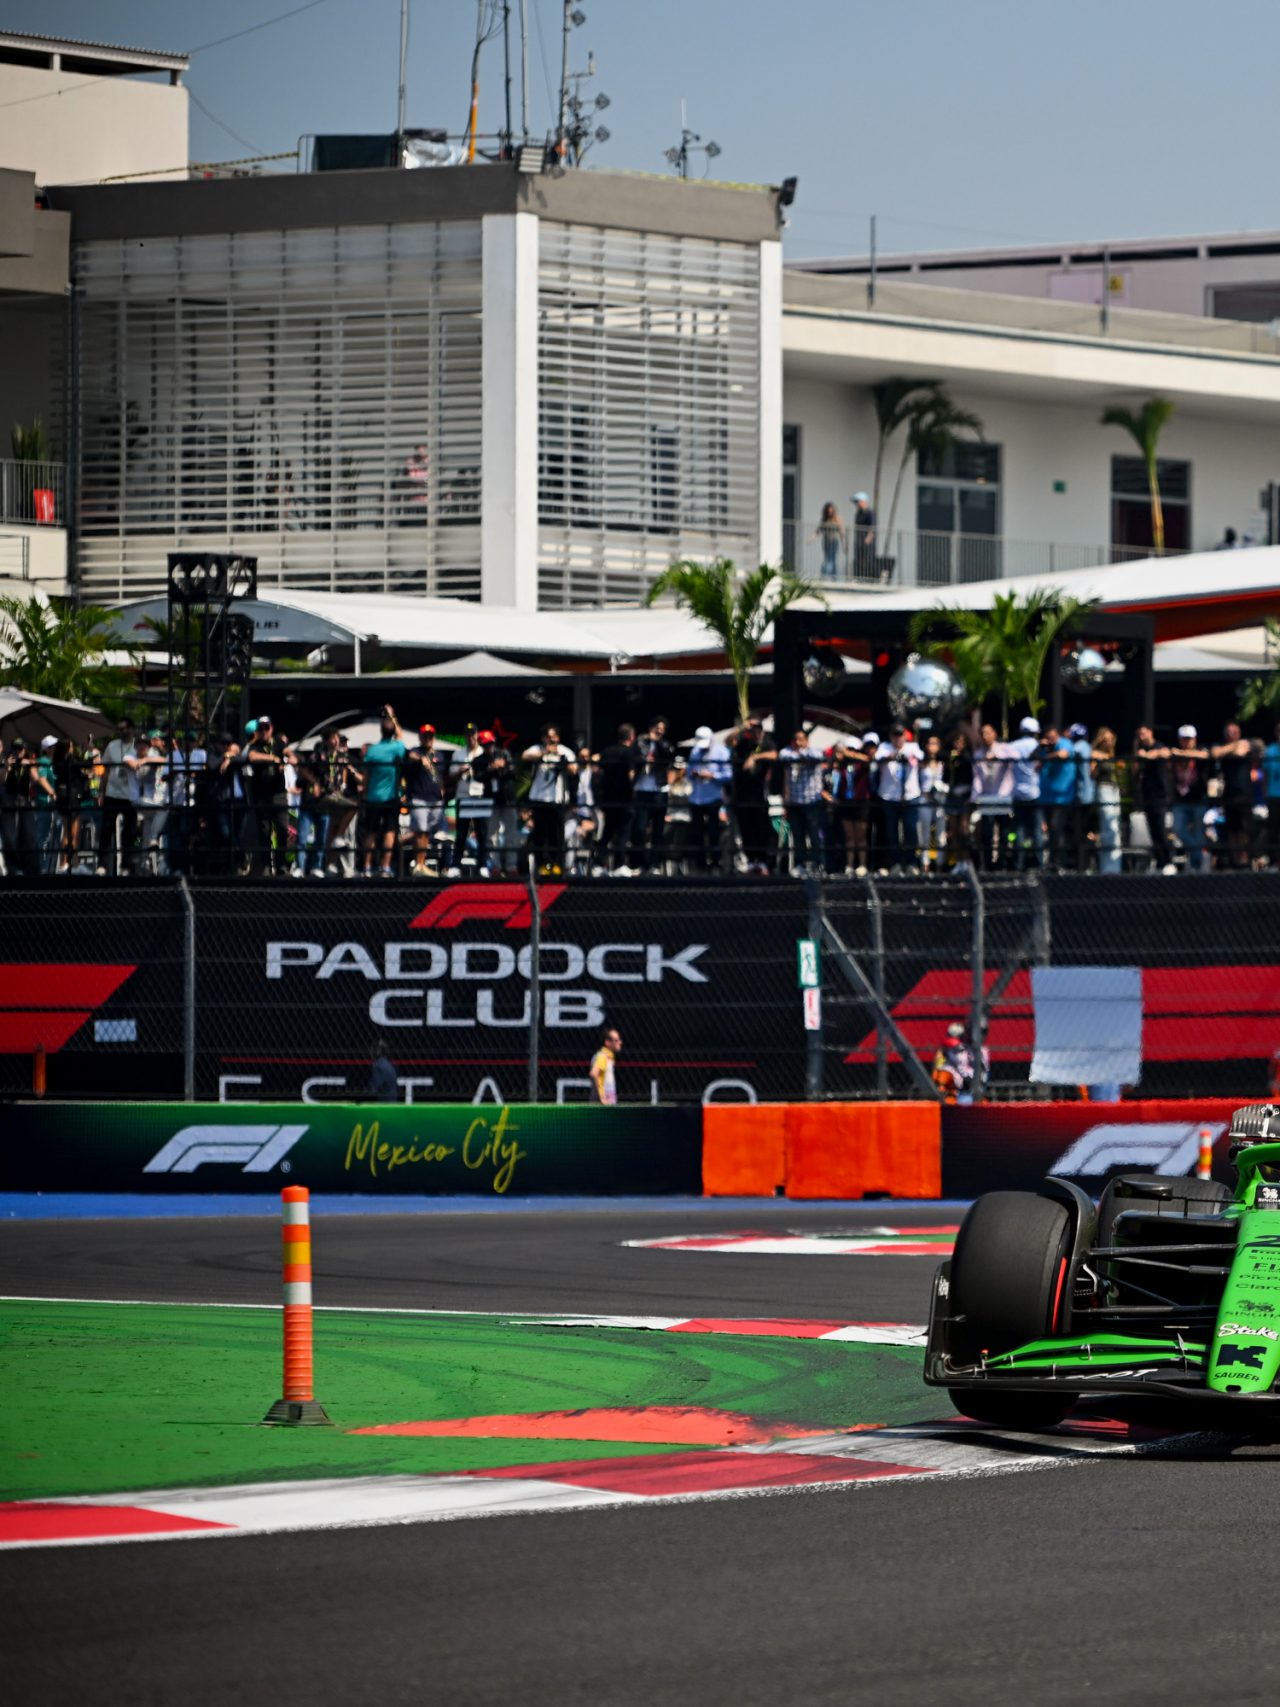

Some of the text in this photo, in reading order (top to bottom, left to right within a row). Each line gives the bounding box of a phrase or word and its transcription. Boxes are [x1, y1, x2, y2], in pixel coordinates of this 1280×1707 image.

[266, 942, 709, 982] PADDOCK
[369, 989, 605, 1027] CLUB
[345, 1105, 525, 1193] Mexico City
[1218, 1322, 1280, 1341] Stake
[1213, 1371, 1261, 1383] SAUBER
